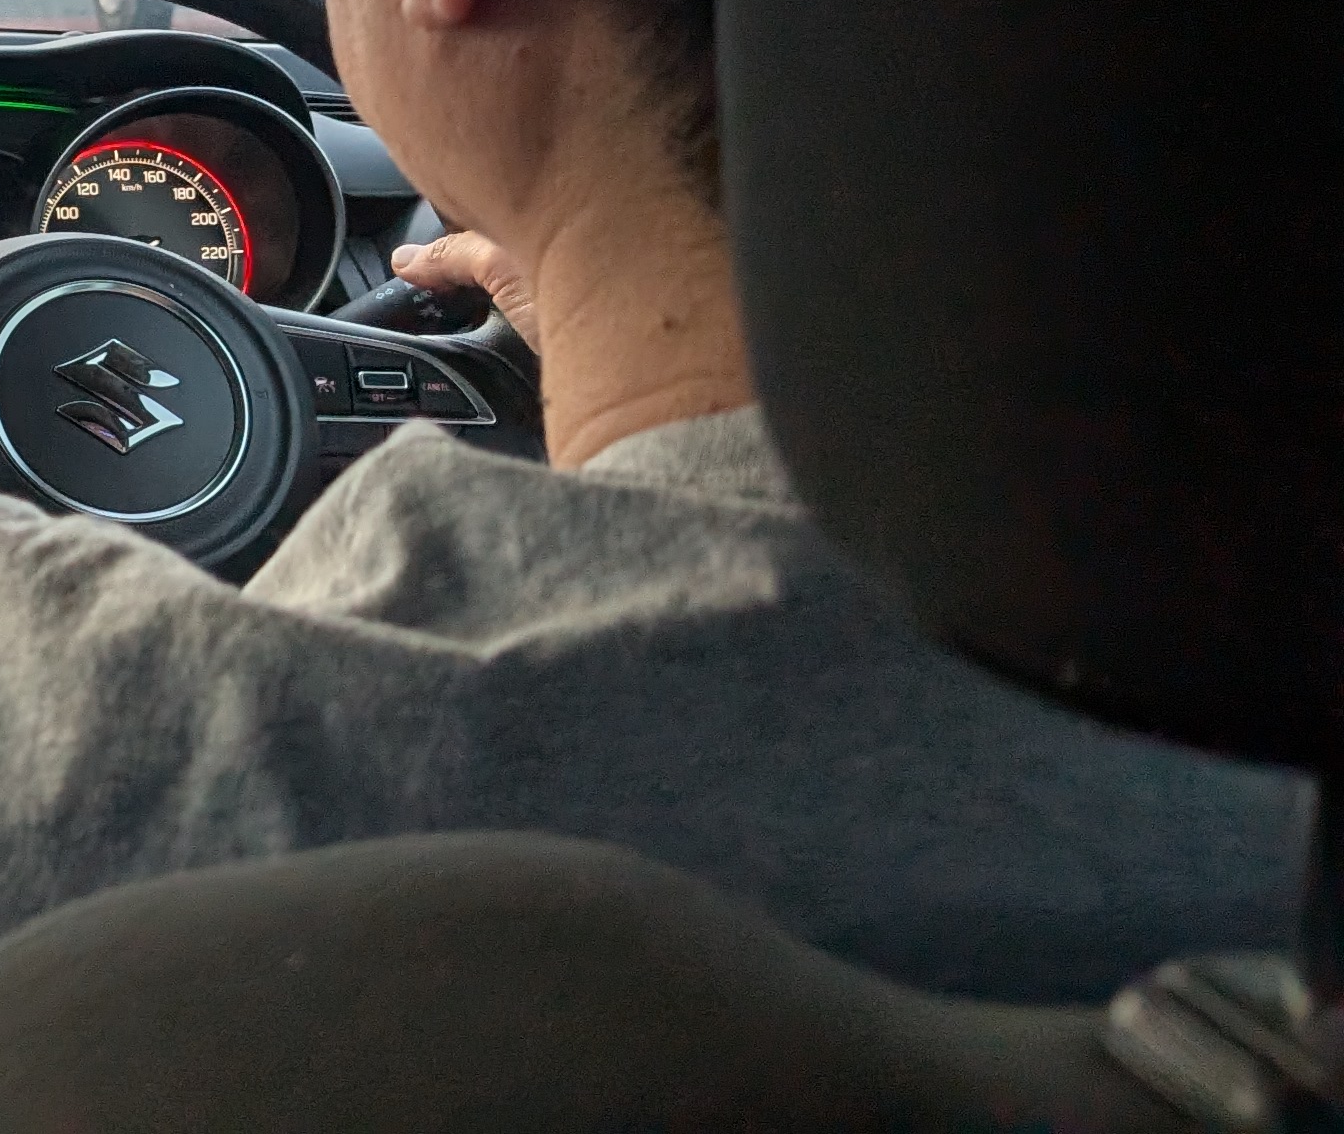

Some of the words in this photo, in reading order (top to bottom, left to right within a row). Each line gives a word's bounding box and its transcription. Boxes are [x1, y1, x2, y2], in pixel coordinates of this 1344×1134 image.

[107, 168, 131, 182] 140
[143, 169, 167, 184] 160
[76, 182, 100, 197] 120
[121, 183, 143, 192] km/h
[173, 187, 197, 201] 180
[55, 206, 80, 222] 100
[191, 212, 218, 227] 200
[200, 245, 228, 260] 220
